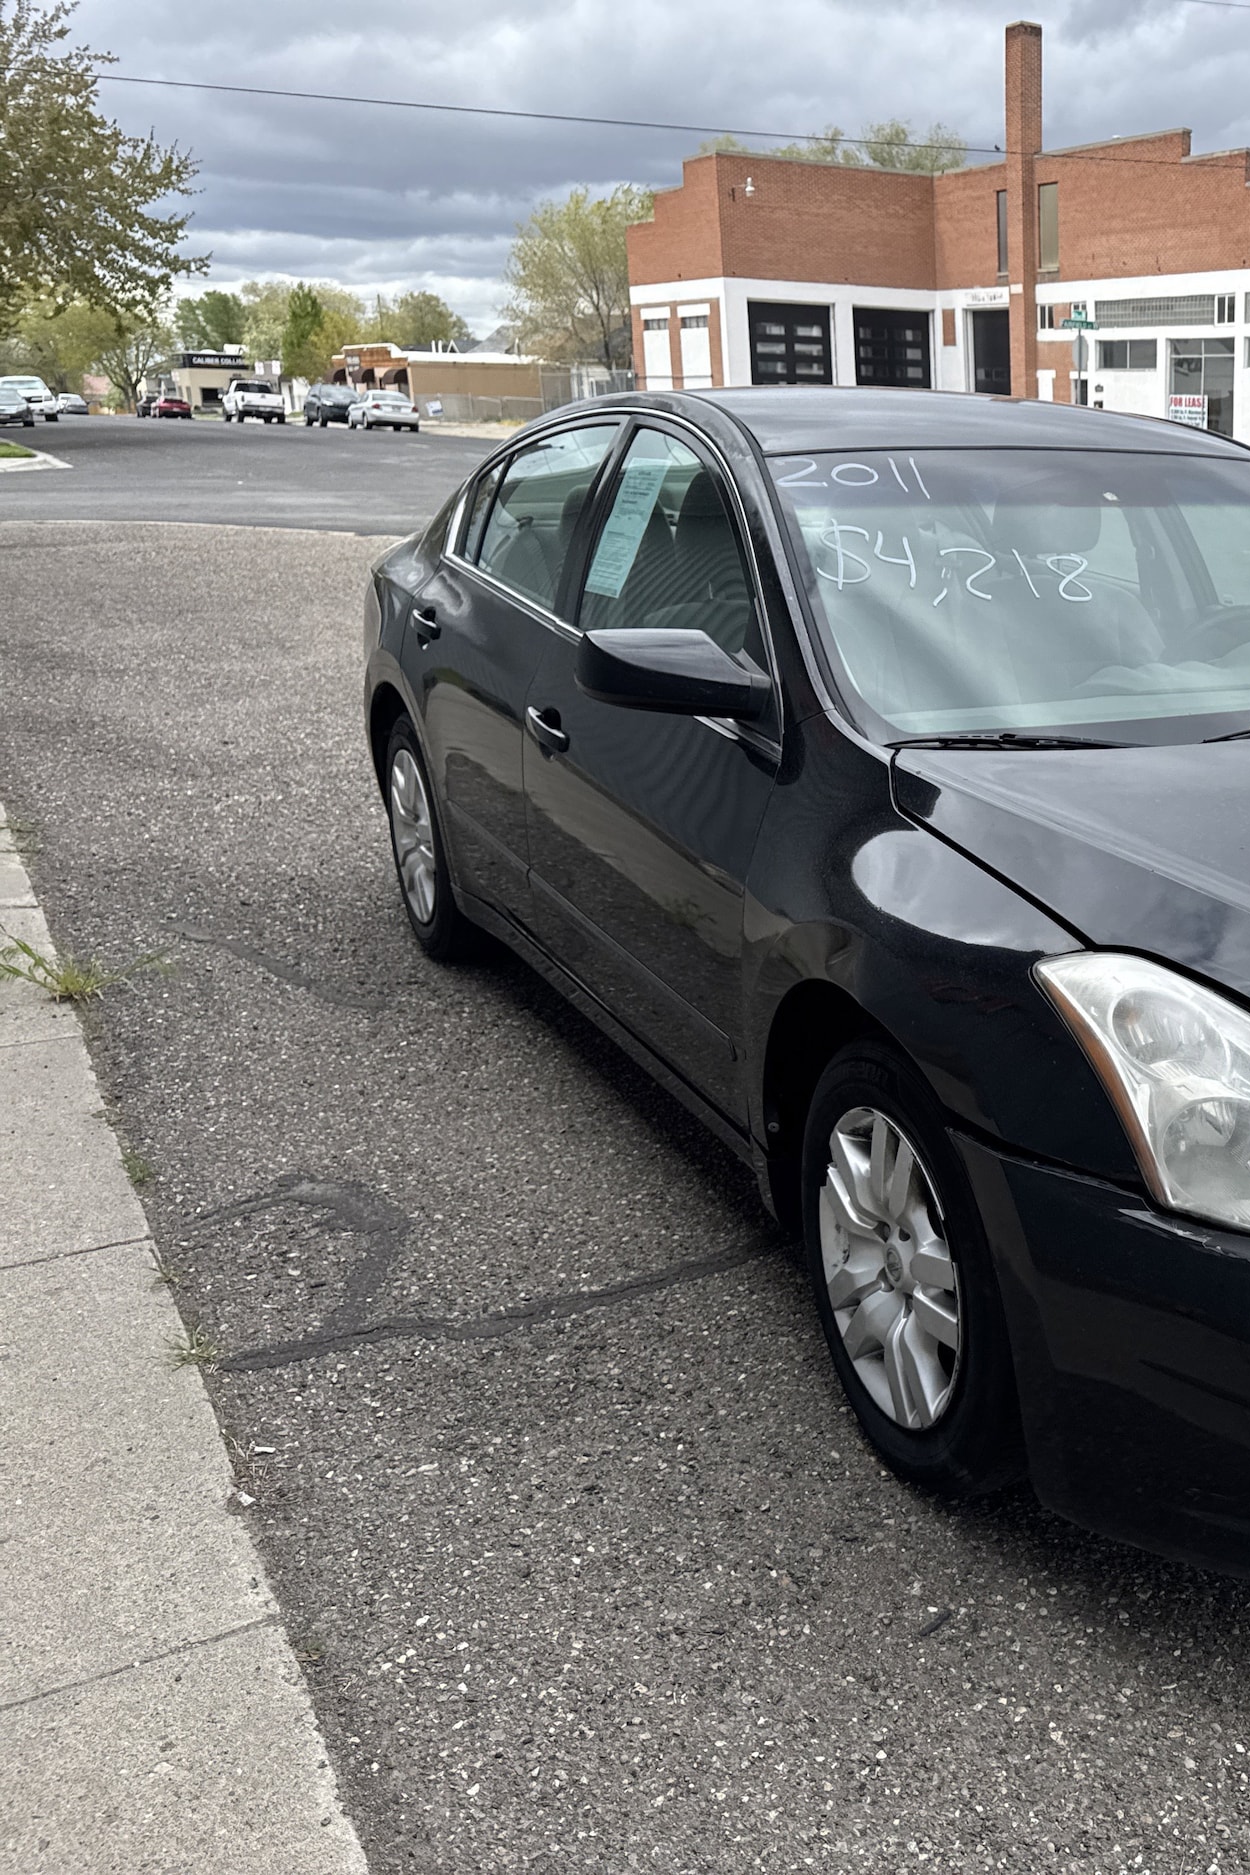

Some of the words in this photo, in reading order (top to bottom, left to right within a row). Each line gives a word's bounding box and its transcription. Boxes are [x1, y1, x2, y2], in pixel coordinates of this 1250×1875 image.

[1170, 397, 1182, 408] FOR
[775, 458, 930, 499] 2011
[816, 518, 1093, 607] $4,218
